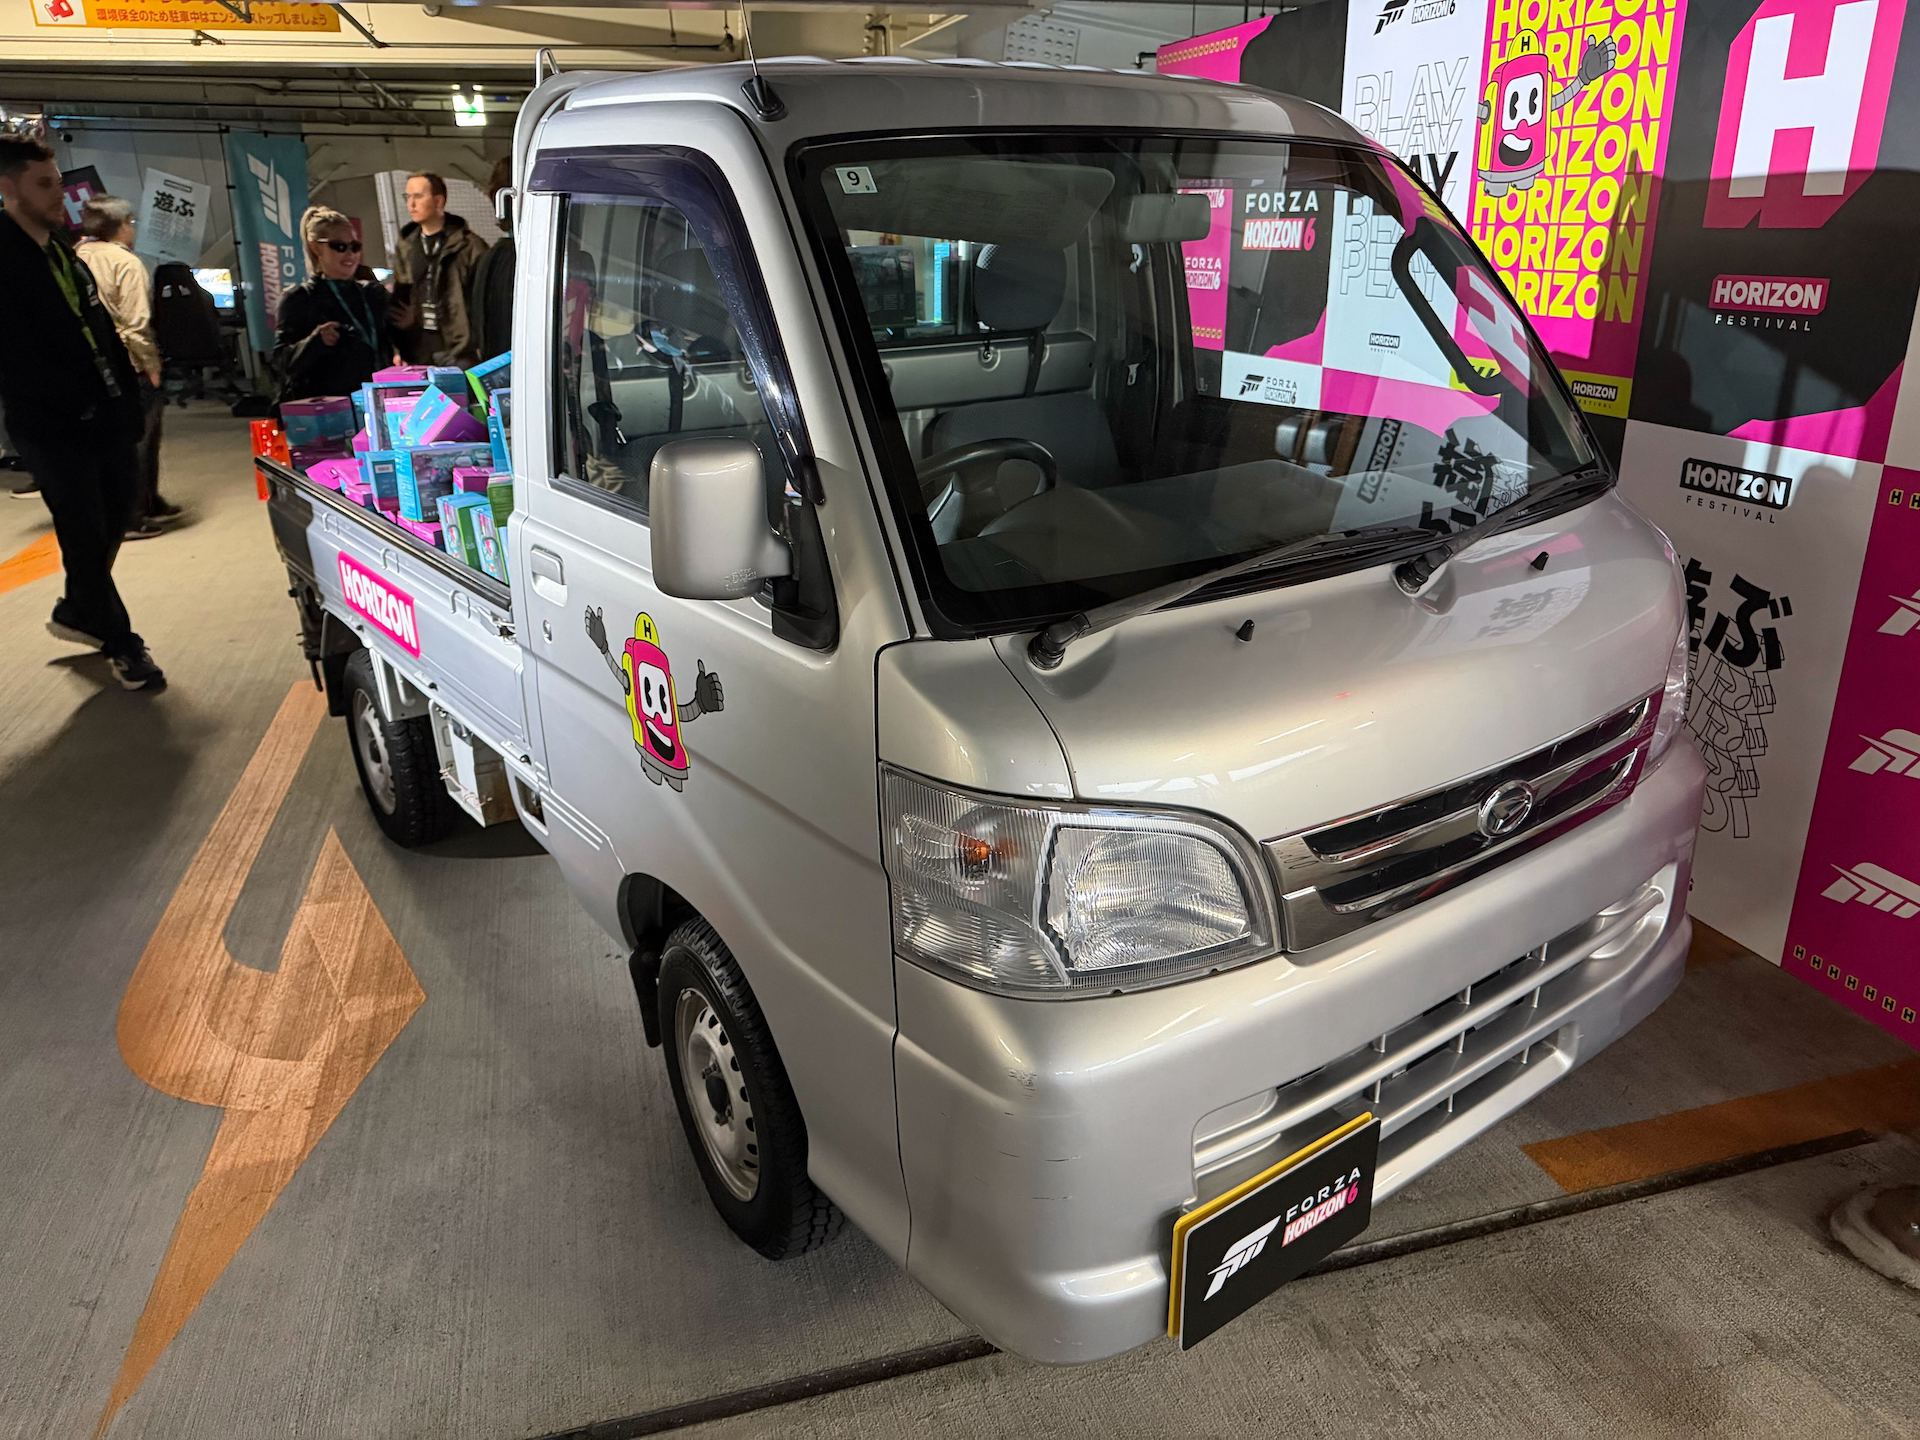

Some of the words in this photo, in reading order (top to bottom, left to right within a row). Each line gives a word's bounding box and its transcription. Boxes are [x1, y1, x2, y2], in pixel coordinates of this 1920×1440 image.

[1449, 0, 1456, 15] 6
[1520, 35, 1531, 53] H
[1728, 0, 1880, 198] H
[846, 171, 860, 186] 9
[153, 190, 195, 217] 遊ぶ
[1245, 190, 1319, 213] FORZA
[1473, 174, 1653, 224] HORIZON
[1243, 220, 1304, 249] HORIZON
[1303, 217, 1316, 251] 6
[1185, 257, 1222, 269] FORZA
[1213, 271, 1221, 290] 6
[1712, 280, 1823, 309] HORIZON
[1714, 314, 1811, 332] FESTIVAL
[1265, 376, 1298, 391] FORZA
[1572, 382, 1617, 400] HORIZON
[1684, 463, 1788, 506] HORIZON
[1889, 489, 1904, 505] H
[1685, 494, 1777, 524] FESTIVAL
[340, 559, 418, 650] HORIZON
[643, 620, 652, 640] H
[1285, 1167, 1361, 1223] FORZA
[1282, 1188, 1349, 1247] HORIZON
[1346, 1180, 1359, 1205] 6
